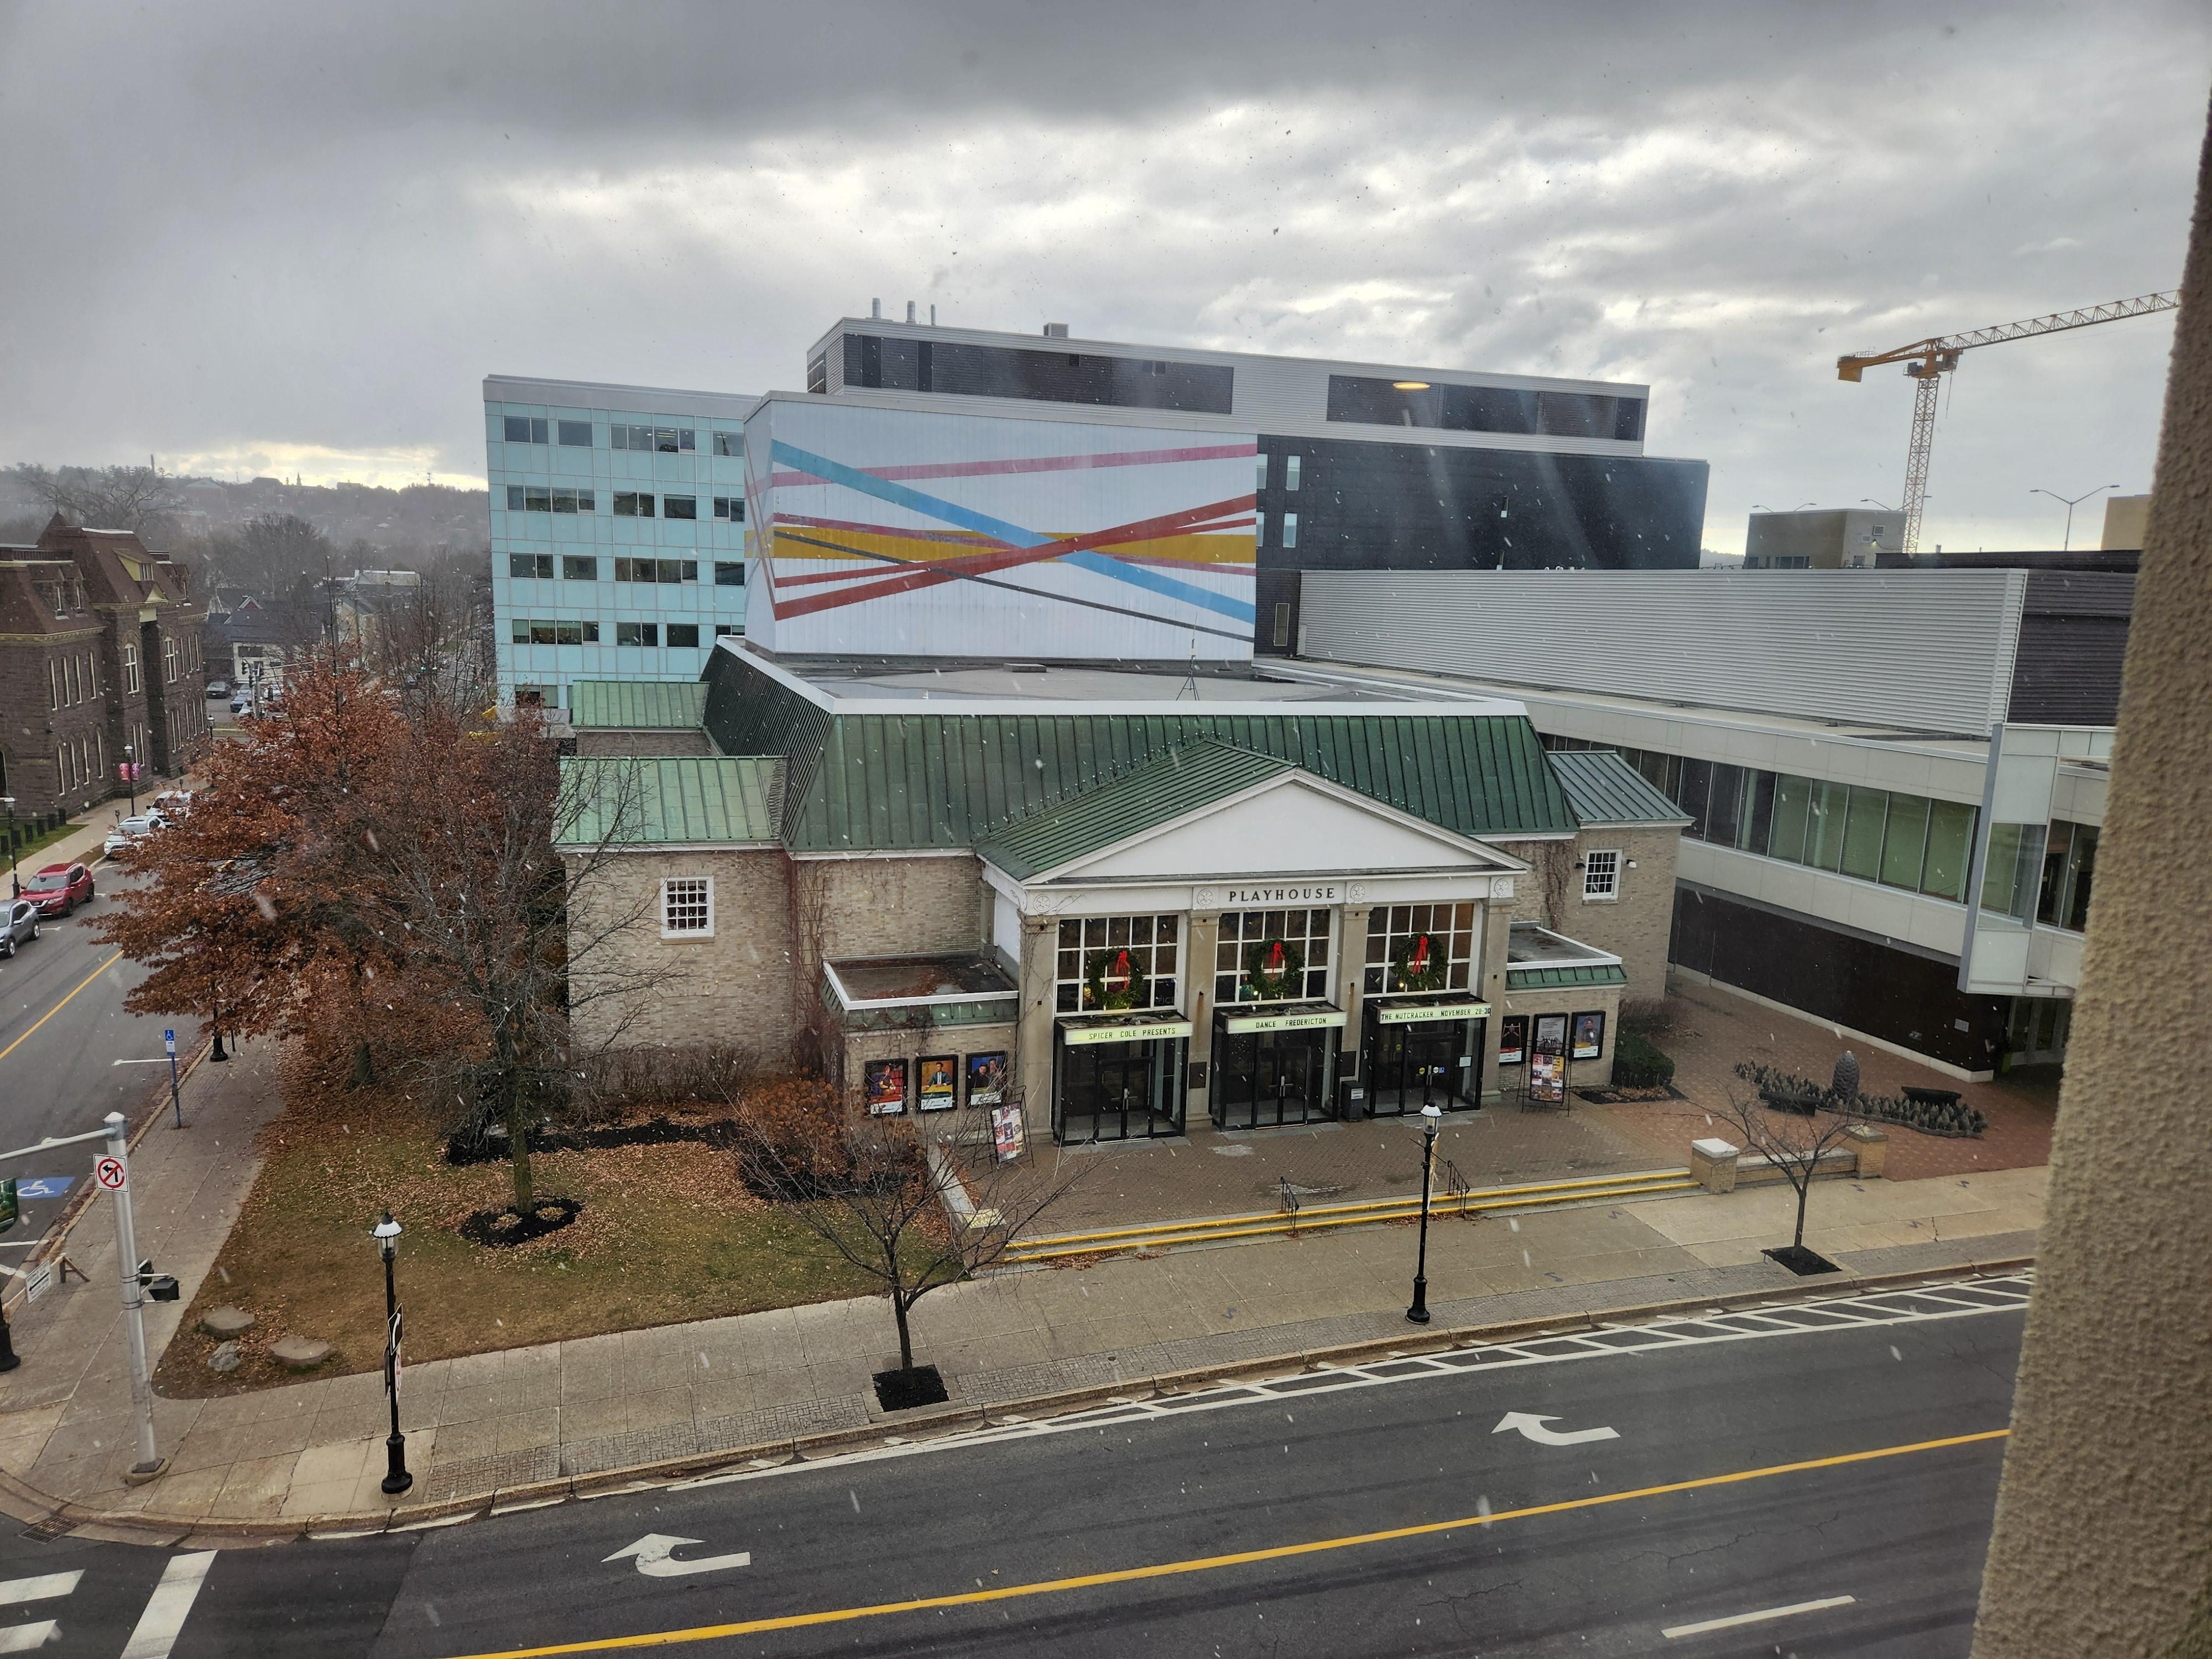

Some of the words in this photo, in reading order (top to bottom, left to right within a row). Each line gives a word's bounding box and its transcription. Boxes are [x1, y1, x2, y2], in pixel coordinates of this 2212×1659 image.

[1229, 888, 1335, 902] PLAYHOUSE
[1395, 1011, 1433, 1020] NUTCRACKER
[1441, 1009, 1471, 1017] NOVEMBER
[1285, 1018, 1327, 1026] FREDERICTON
[1142, 1027, 1176, 1036] PRESENTS
